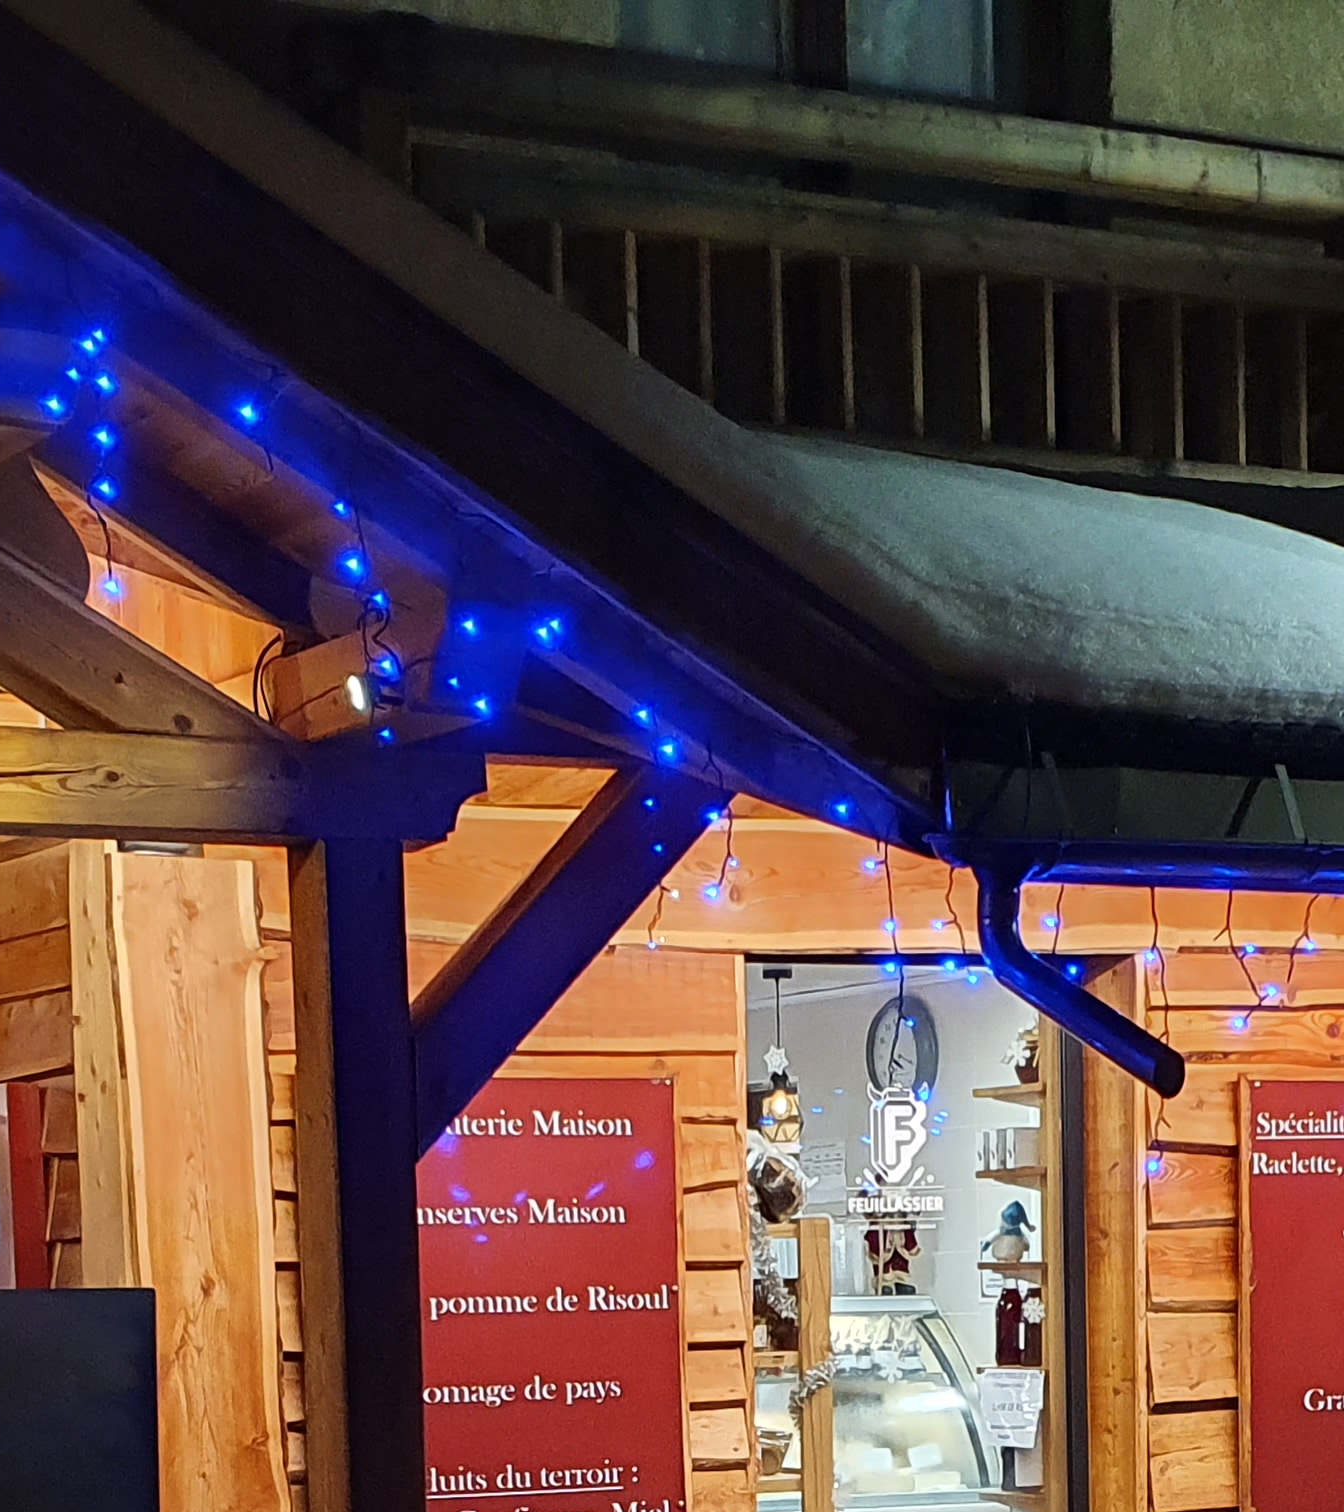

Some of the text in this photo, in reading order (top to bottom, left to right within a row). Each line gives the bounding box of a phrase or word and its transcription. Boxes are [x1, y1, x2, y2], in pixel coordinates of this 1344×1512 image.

[532, 1109, 633, 1136] Maison
[1252, 1150, 1344, 1176] Raclette,
[527, 1197, 626, 1224] Maison
[848, 1195, 944, 1213] FEUILLASSIER
[430, 1284, 670, 1321] pomme de Risoul
[524, 1375, 557, 1400] de
[566, 1380, 622, 1405] pays
[496, 1463, 532, 1489] du
[541, 1458, 624, 1487] terroir
